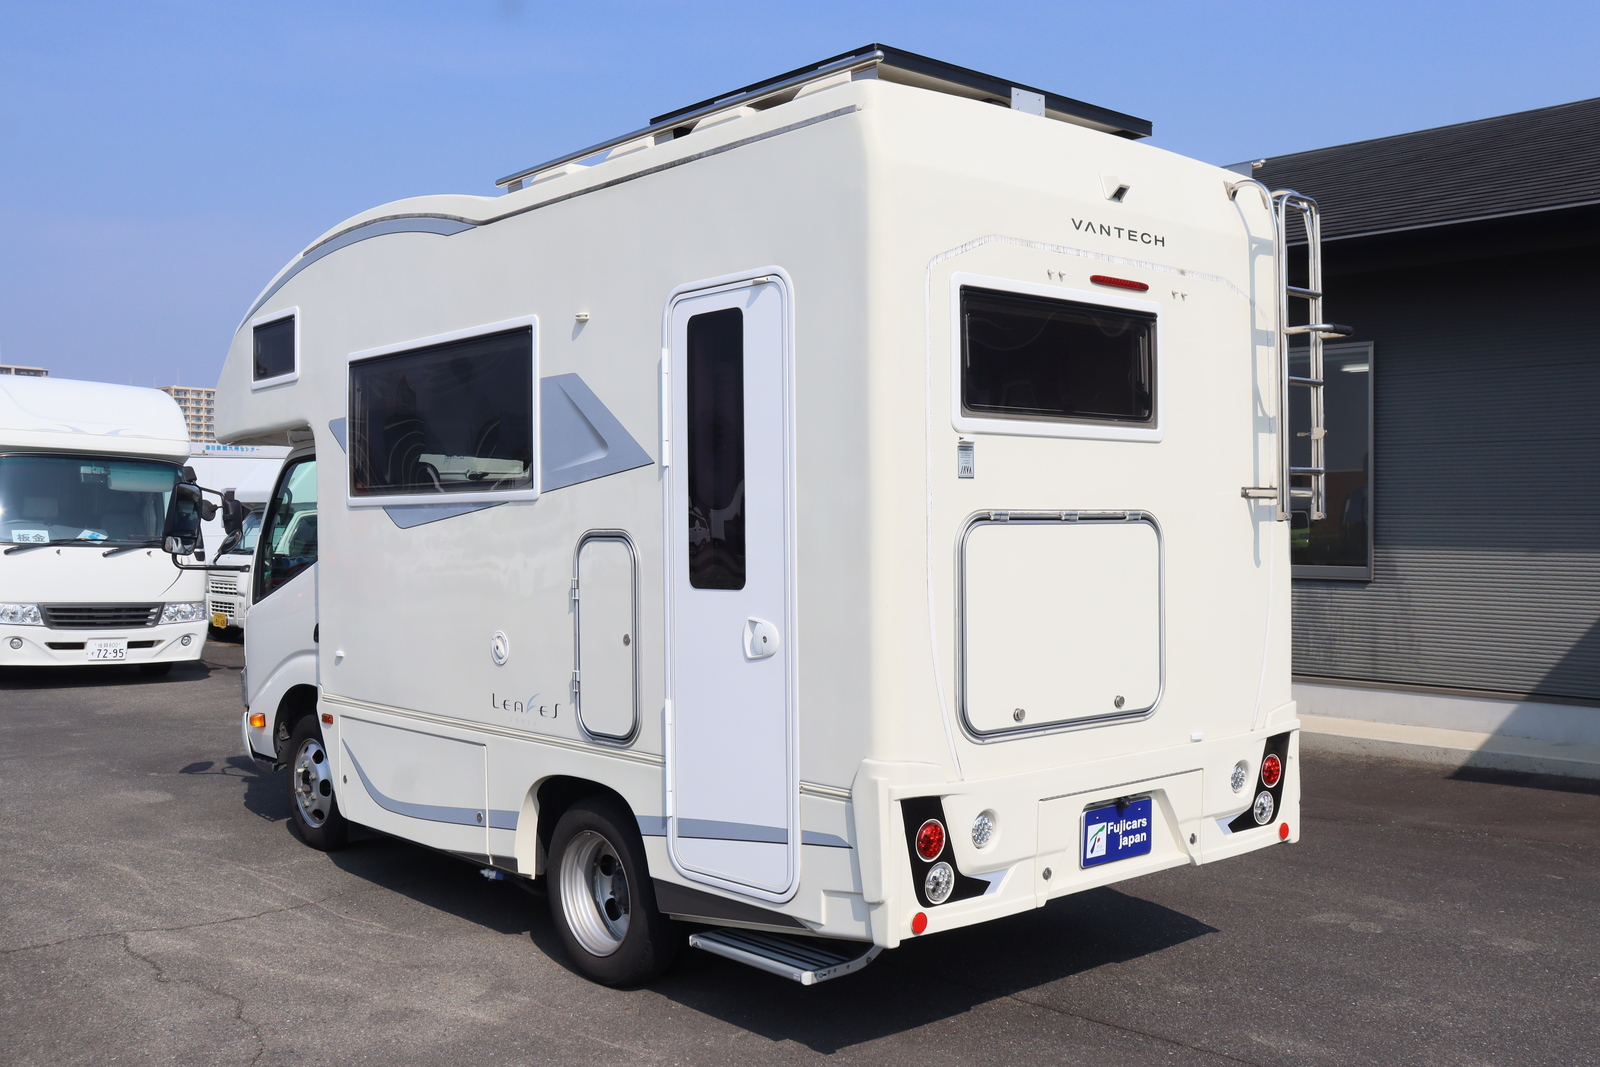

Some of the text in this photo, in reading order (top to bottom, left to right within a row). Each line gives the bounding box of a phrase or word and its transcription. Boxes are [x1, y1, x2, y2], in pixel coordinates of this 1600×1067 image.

[1071, 217, 1165, 248] VANTECH
[17, 533, 46, 542] 板金
[96, 648, 124, 659] 72-95
[1107, 817, 1148, 835] Fujicars
[1118, 832, 1147, 850] japan
